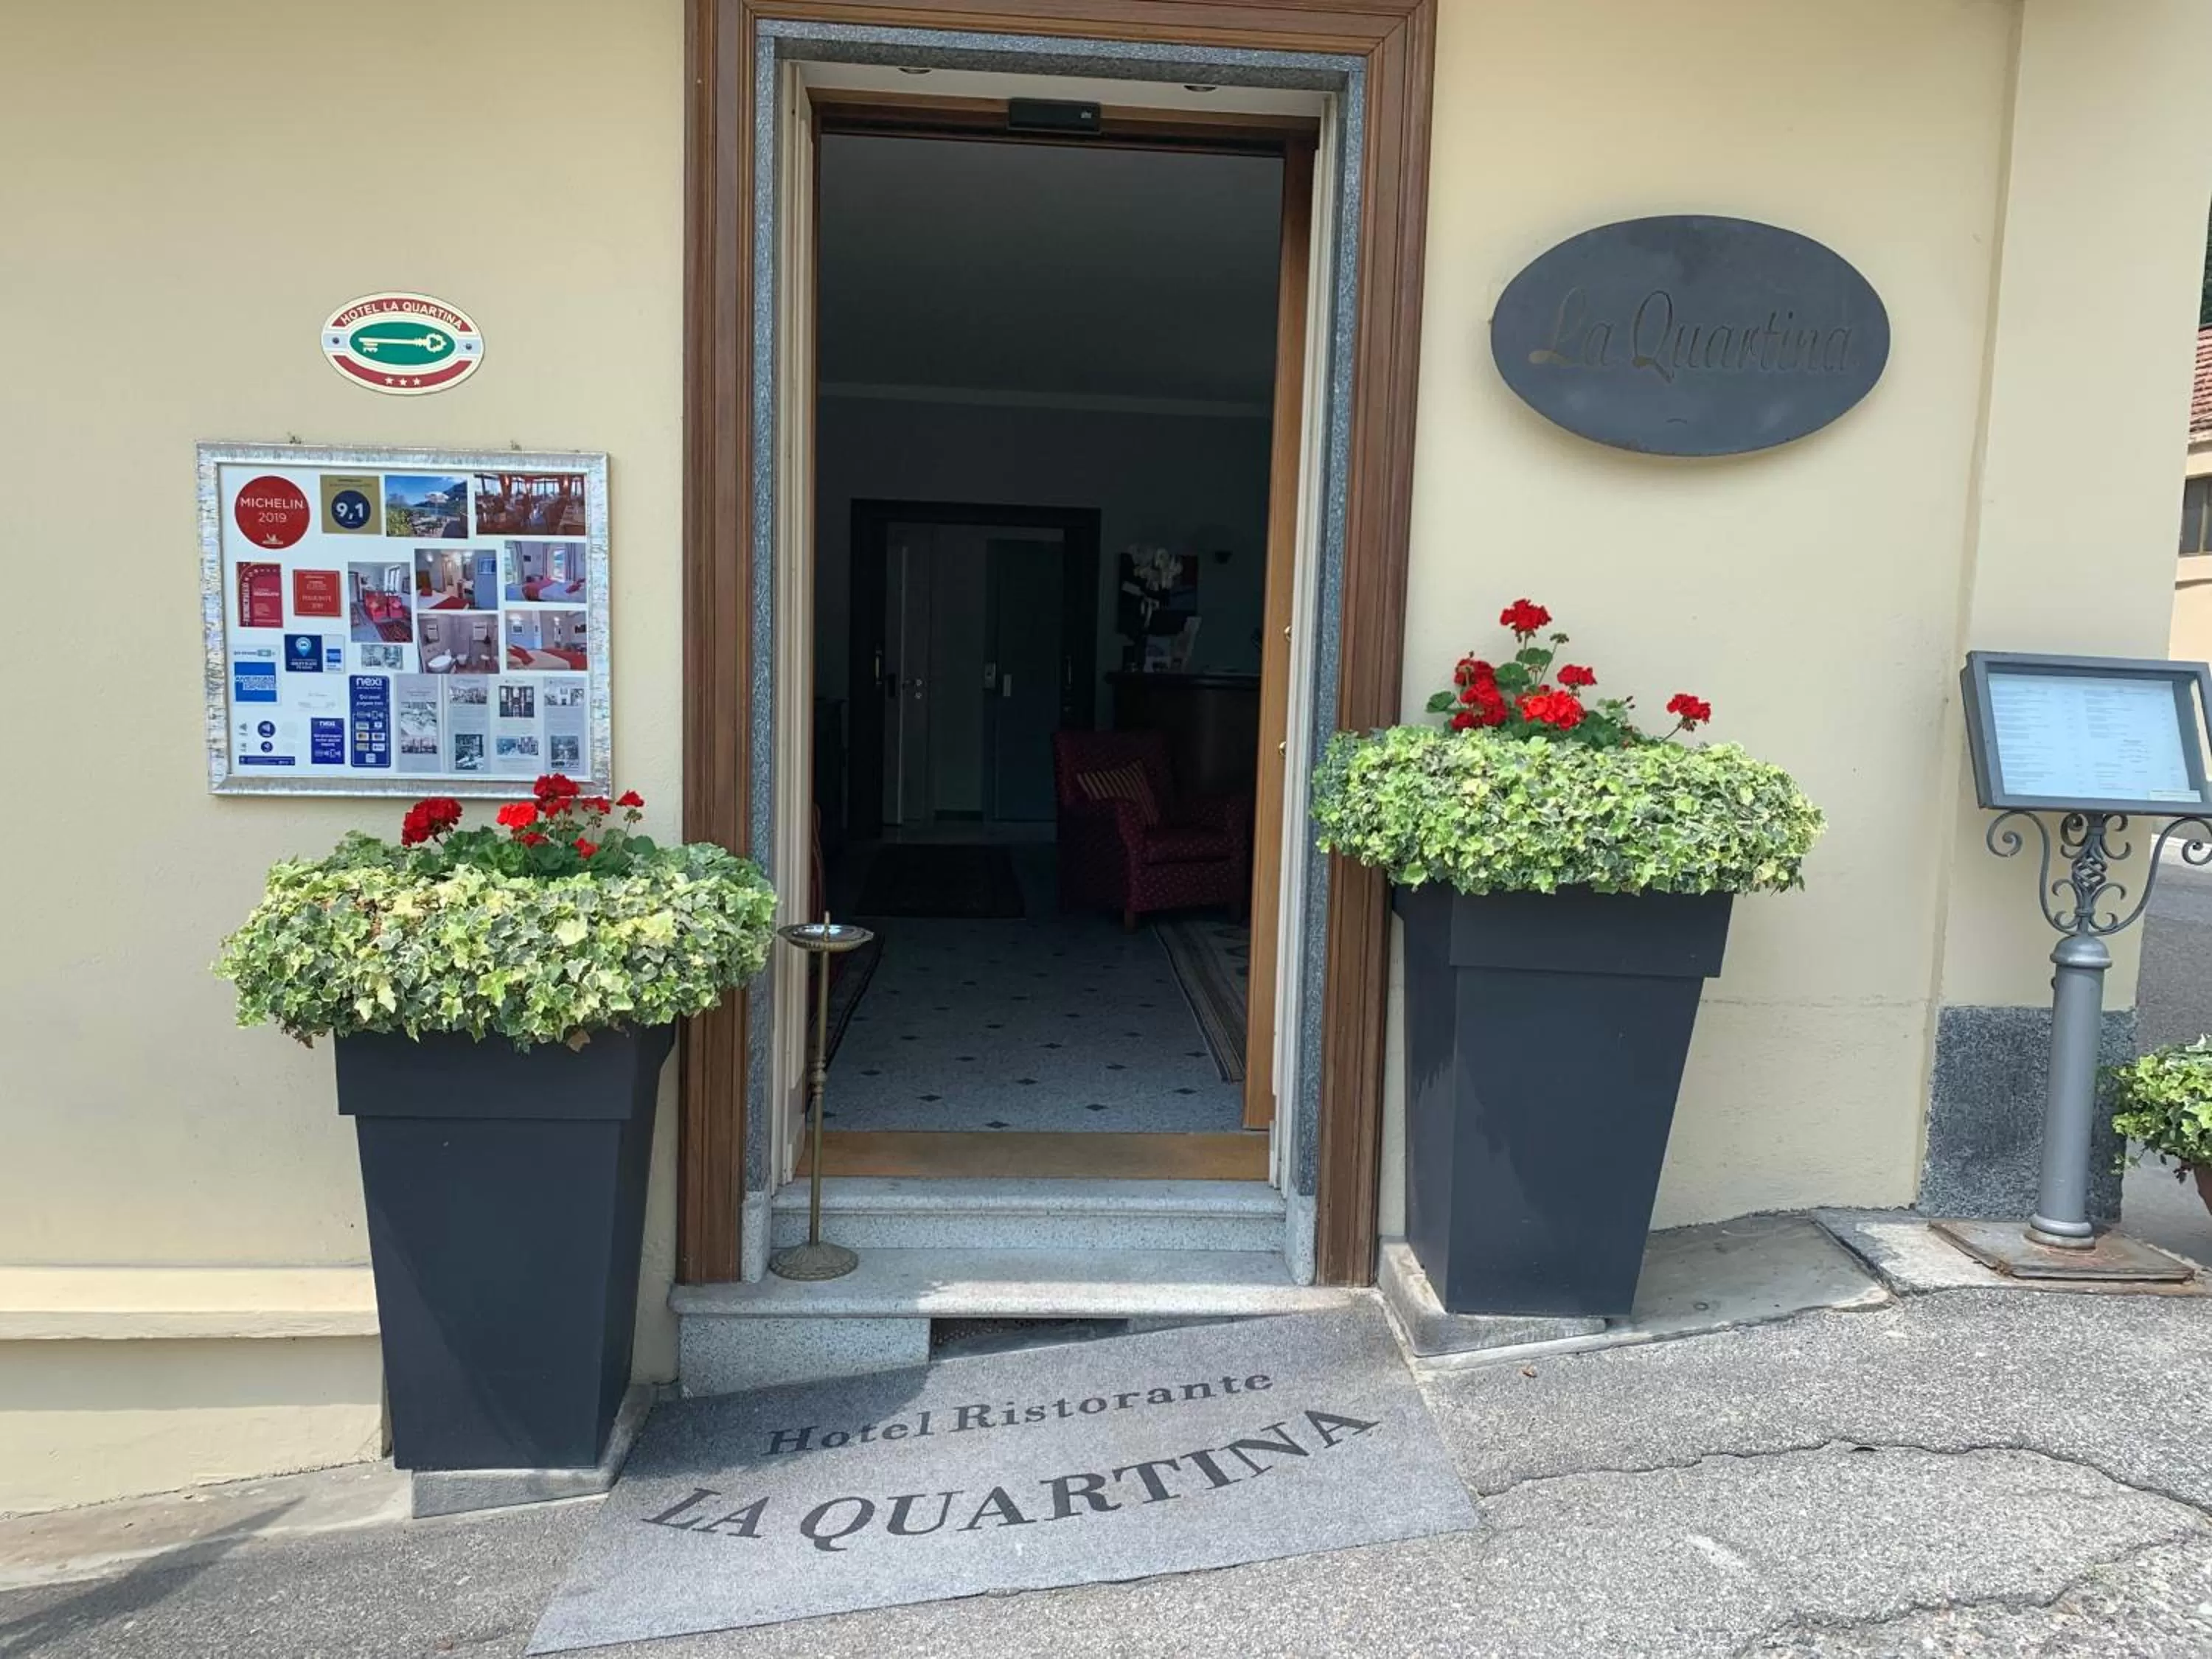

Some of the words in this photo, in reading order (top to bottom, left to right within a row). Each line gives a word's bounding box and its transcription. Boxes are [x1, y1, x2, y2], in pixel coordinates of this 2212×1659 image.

[340, 303, 380, 325] HOTEL
[383, 301, 399, 311] LA
[403, 301, 463, 330] QUARTINA
[1528, 286, 1615, 367] La
[1632, 289, 1853, 383] Quartina
[240, 497, 304, 509] MICHELIN
[336, 502, 364, 520] 9,1
[259, 512, 287, 523] 2019
[356, 678, 383, 686] nexi
[760, 1411, 936, 1457] Hotel
[948, 1373, 1274, 1433] Ristorante
[639, 1486, 771, 1539] LA
[799, 1410, 1381, 1552] QUARTINA
